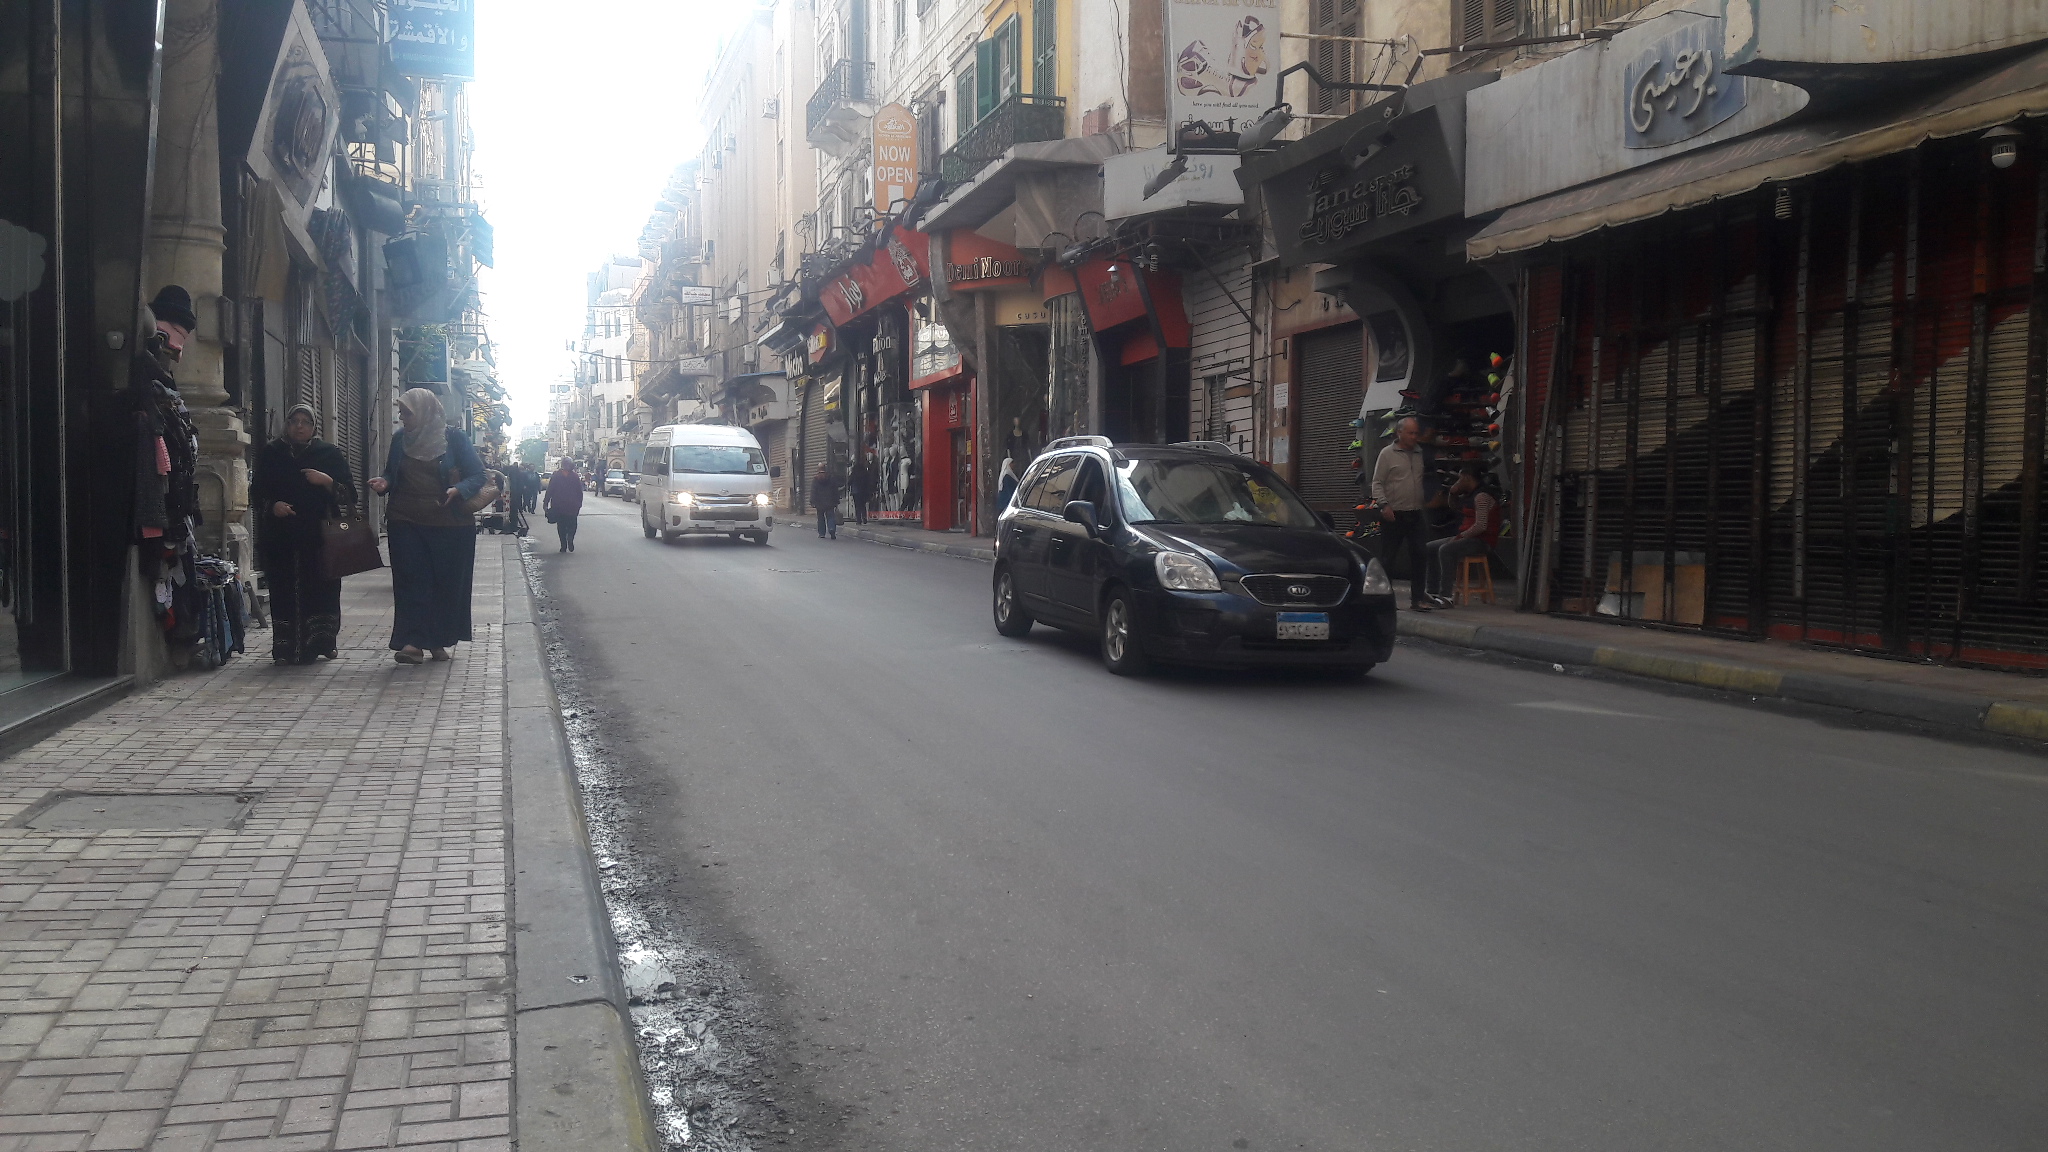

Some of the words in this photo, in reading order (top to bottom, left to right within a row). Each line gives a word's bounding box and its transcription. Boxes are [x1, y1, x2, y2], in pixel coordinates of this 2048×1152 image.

[879, 145, 911, 162] NOW
[876, 166, 913, 184] OPEN
[1291, 586, 1307, 594] KIA
